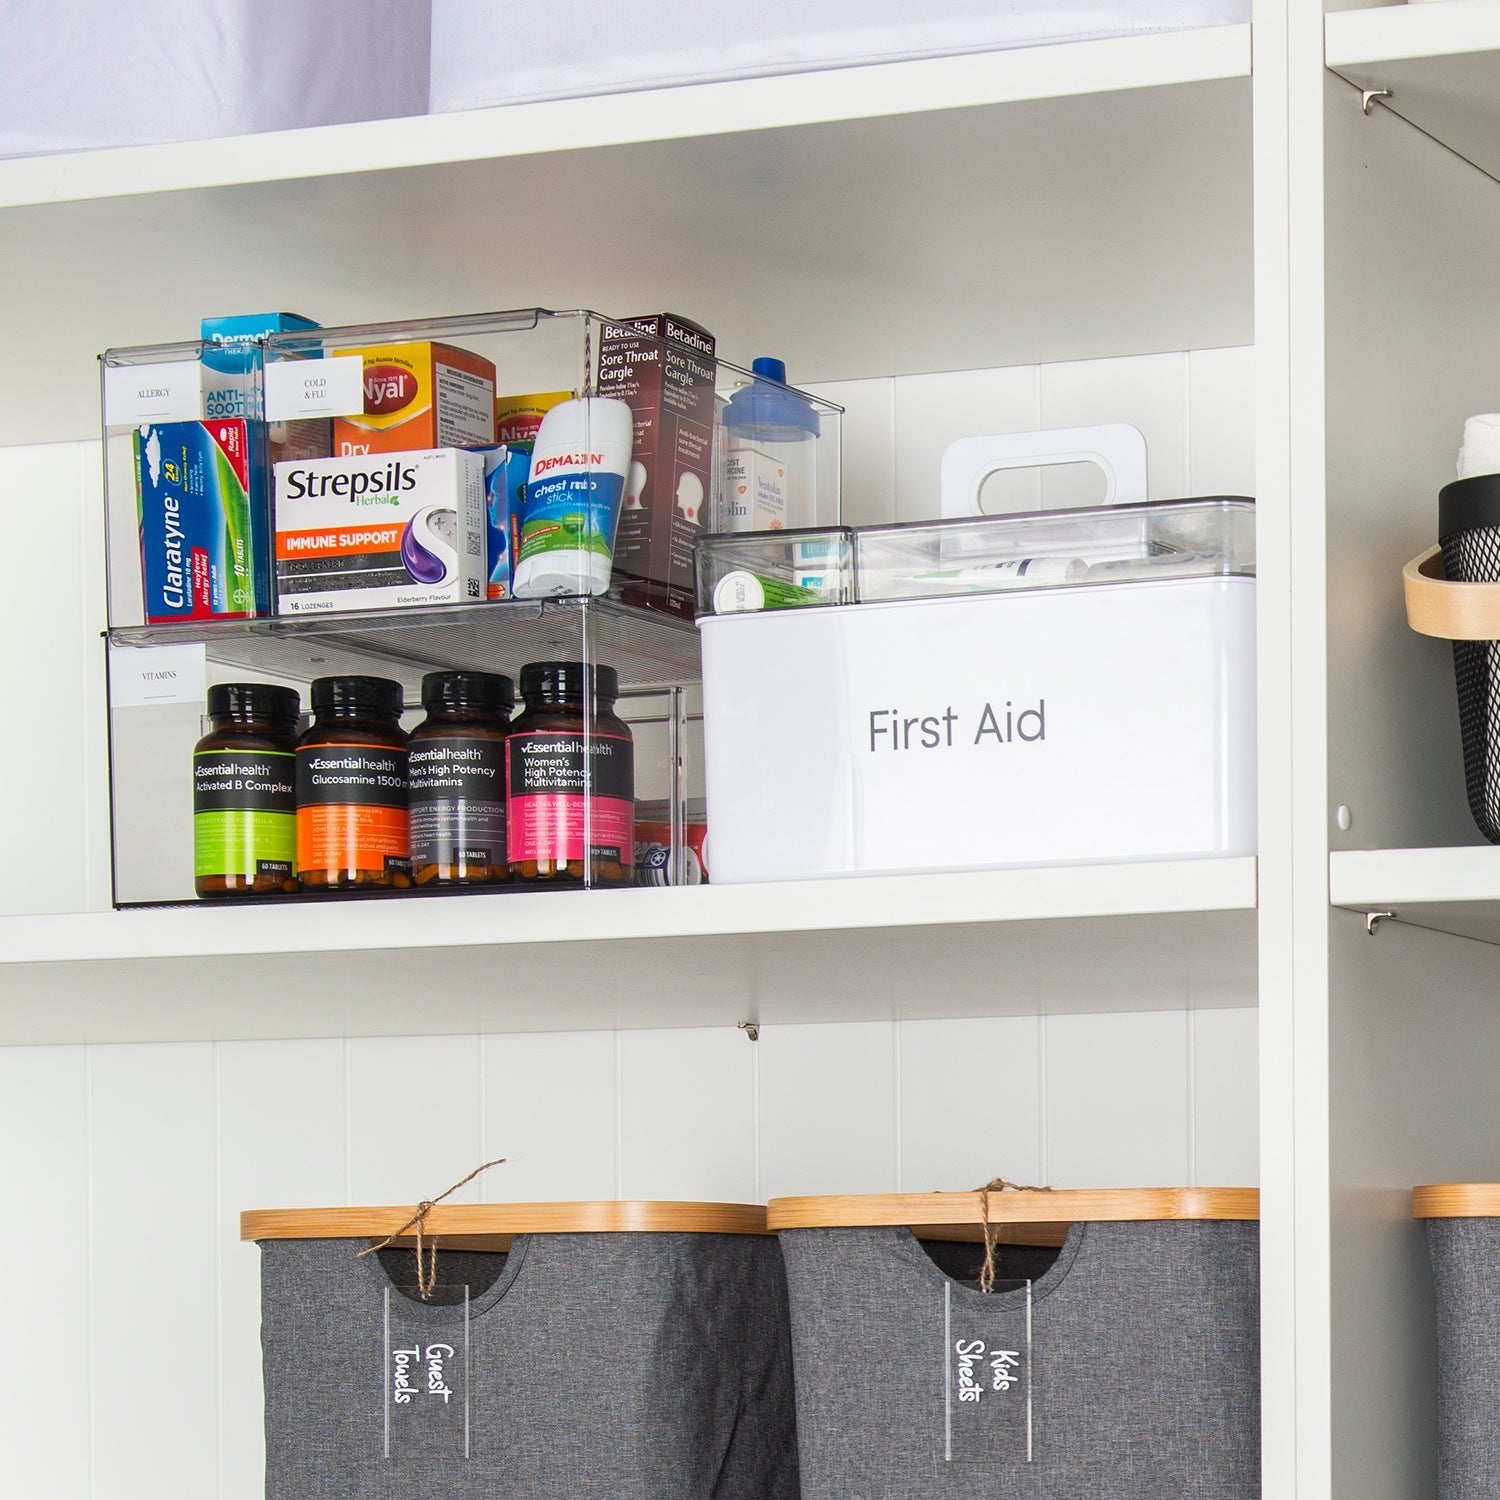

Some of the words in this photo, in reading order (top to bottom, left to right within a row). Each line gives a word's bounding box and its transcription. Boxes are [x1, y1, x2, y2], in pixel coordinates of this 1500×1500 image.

[667, 322, 712, 354] Betadine
[394, 357, 414, 369] families
[601, 353, 623, 367] Sore
[624, 349, 659, 363] Throat
[666, 350, 685, 368] Sore
[687, 360, 714, 381] Throat
[600, 365, 633, 382] Gargle
[665, 364, 694, 386] Gargle
[304, 379, 327, 388] COLD
[363, 375, 404, 405] Nyal
[137, 388, 170, 399] ALLERGY
[312, 390, 327, 398] FLU
[341, 442, 370, 457] Dry
[165, 463, 176, 482] 24
[287, 462, 416, 502] Strepsils
[534, 480, 567, 498] chest
[356, 493, 389, 506] Herbal
[546, 491, 574, 505] stick
[287, 534, 337, 550] IMMUNE
[339, 530, 398, 547] SUPPORT
[163, 496, 185, 608] Claratyne
[236, 538, 244, 563] TABLETS
[200, 554, 208, 577] Relief
[234, 565, 245, 577] 10
[201, 579, 209, 606] Allergy
[397, 596, 428, 604] Elderberry
[290, 602, 299, 610] 16
[301, 602, 334, 610] LOZENGES
[142, 671, 177, 680] VITAMINS
[870, 706, 958, 752] First
[974, 699, 1045, 745] Aid
[524, 757, 570, 767] Women's
[409, 766, 426, 777] Men's
[428, 765, 450, 776] High
[453, 764, 496, 777] Potency
[525, 768, 546, 779] High
[196, 780, 232, 792] Activated
[235, 780, 243, 790] B
[245, 780, 292, 793] Complex
[312, 774, 375, 785] Glucosamine
[377, 775, 401, 788] 1500
[409, 778, 463, 789] Multivitamins
[457, 806, 505, 814] PRODUCTION
[269, 863, 288, 871] TABLETS
[392, 1344, 420, 1404] Towels
[425, 1343, 454, 1404] Guest
[955, 1339, 985, 1403] Sheets
[990, 1350, 1020, 1391] Kids
